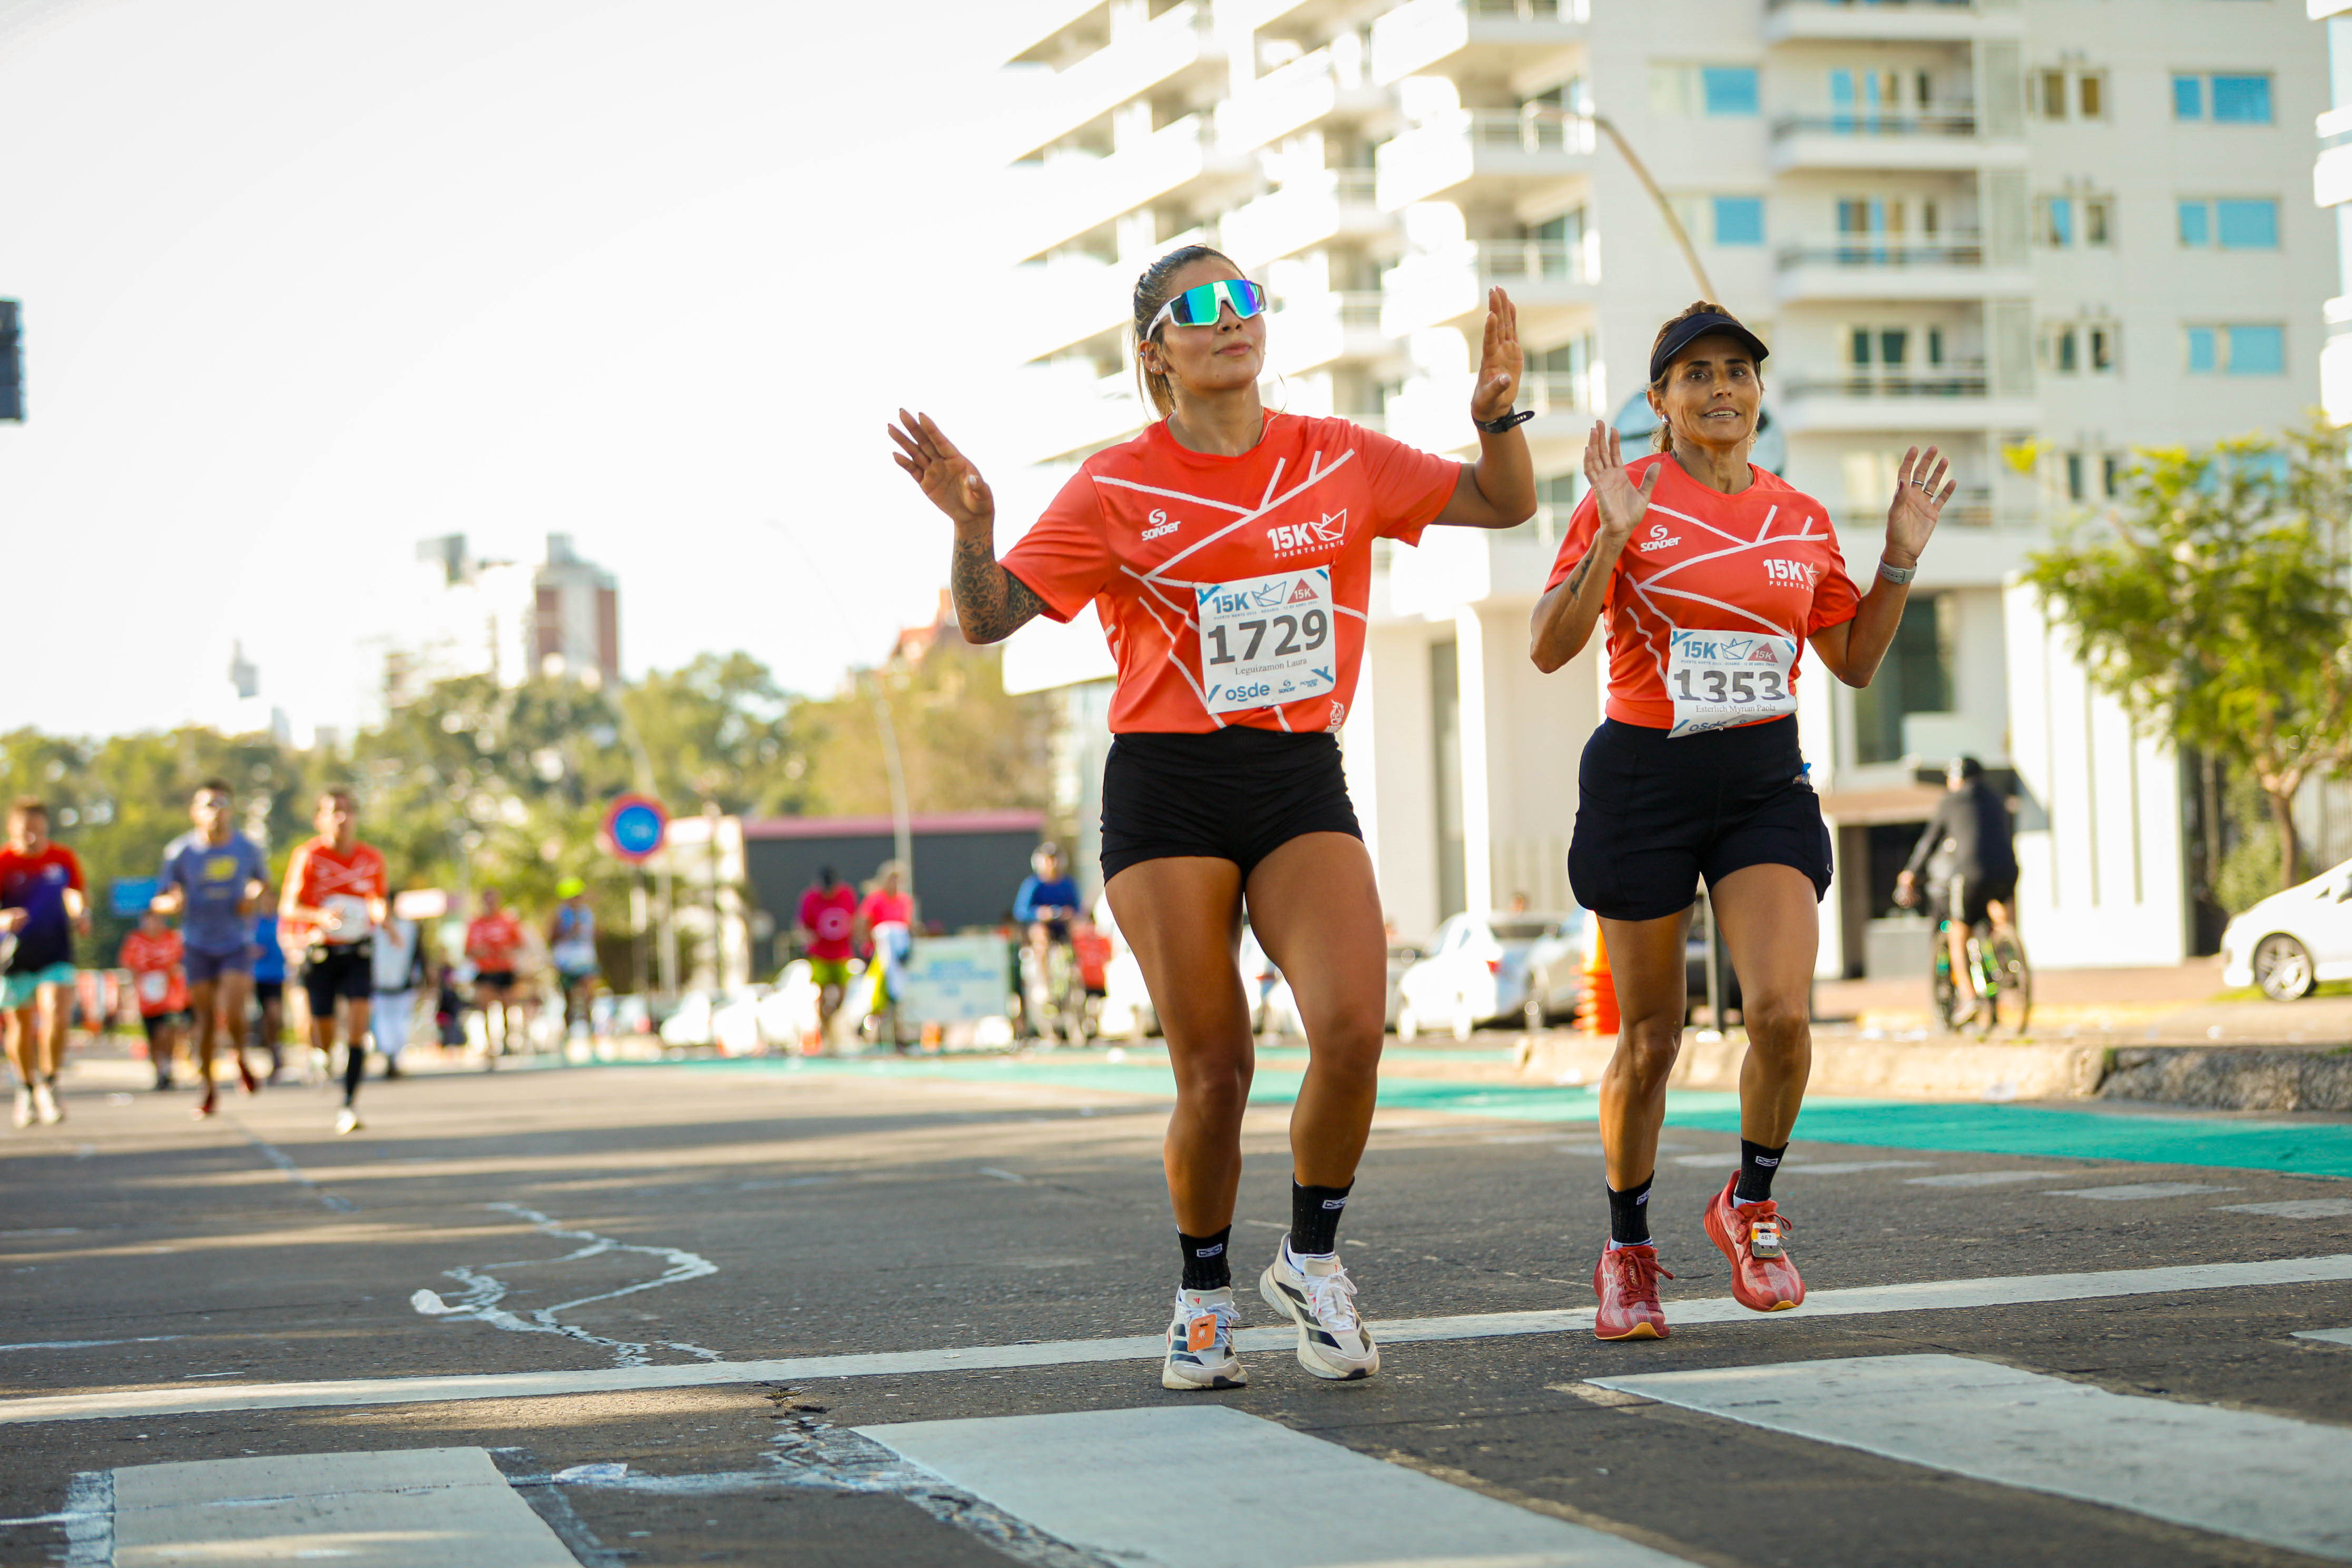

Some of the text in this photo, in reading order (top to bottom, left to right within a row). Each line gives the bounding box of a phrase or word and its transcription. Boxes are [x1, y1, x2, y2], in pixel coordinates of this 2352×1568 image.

[1267, 522, 1314, 551] 15K
[1275, 540, 1345, 558] PUERTO NORTE
[1763, 559, 1804, 582] 15K
[1293, 588, 1311, 600] 15K
[1769, 581, 1804, 589] PUERTO
[1212, 592, 1250, 613] 15K
[1208, 610, 1328, 665] 1729
[1682, 641, 1718, 659] 15K
[1755, 650, 1773, 660] 15K
[1235, 659, 1307, 675] Leguizamon Laura
[1226, 682, 1270, 701] osde
[1674, 669, 1785, 703] 1353
[1729, 705, 1756, 714] Myrian
